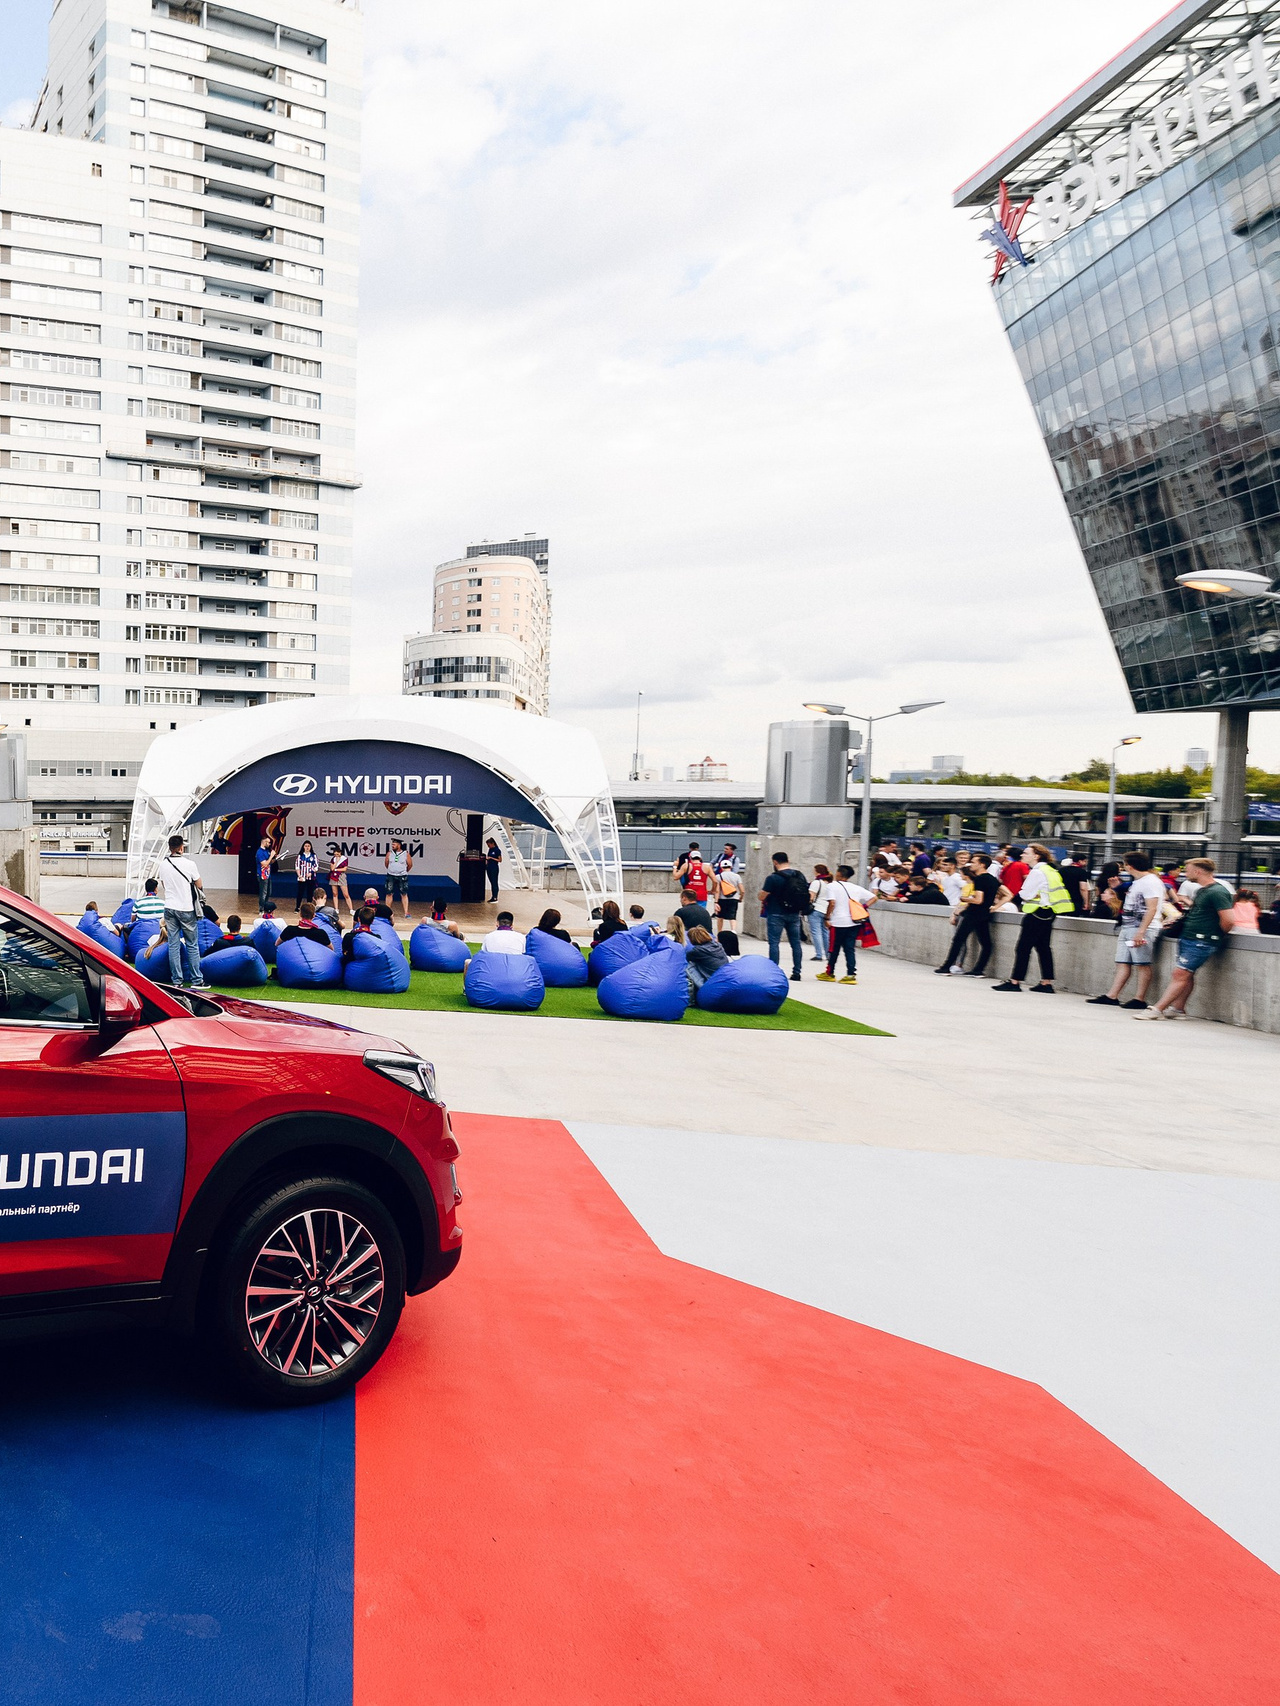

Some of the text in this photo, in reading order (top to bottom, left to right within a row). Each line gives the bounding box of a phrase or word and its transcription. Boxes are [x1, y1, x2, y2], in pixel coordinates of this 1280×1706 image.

[325, 775, 452, 795] HYUNDAI
[296, 826, 441, 838] В ЦЕНТРЕ ФУТБОЛЬНЫХ
[37, 1202, 81, 1215] партнёр
